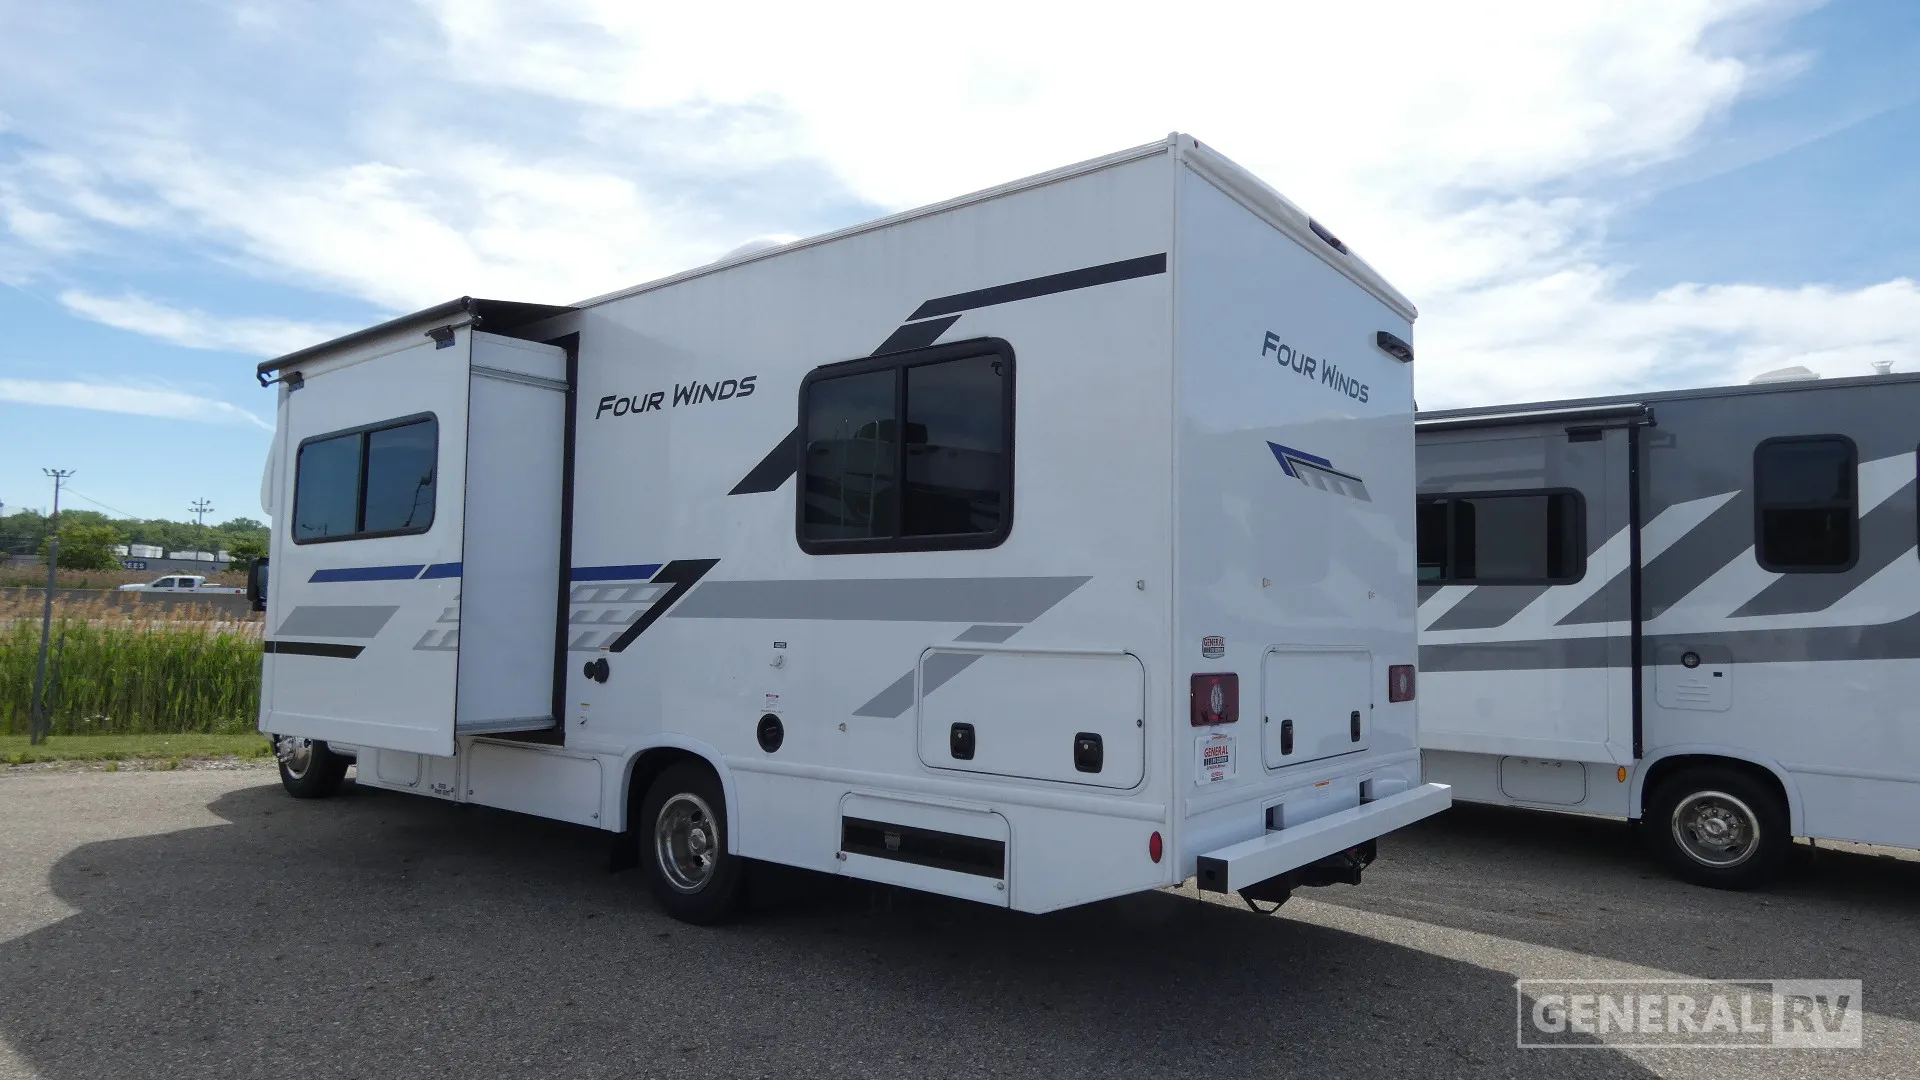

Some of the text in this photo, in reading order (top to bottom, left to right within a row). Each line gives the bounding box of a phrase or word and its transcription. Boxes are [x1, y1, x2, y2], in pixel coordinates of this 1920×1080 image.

[1261, 330, 1369, 404] FOUR WINDS
[595, 375, 758, 419] FOUR WINDS
[1203, 638, 1225, 647] GENERAL
[1204, 745, 1228, 758] GENERAL
